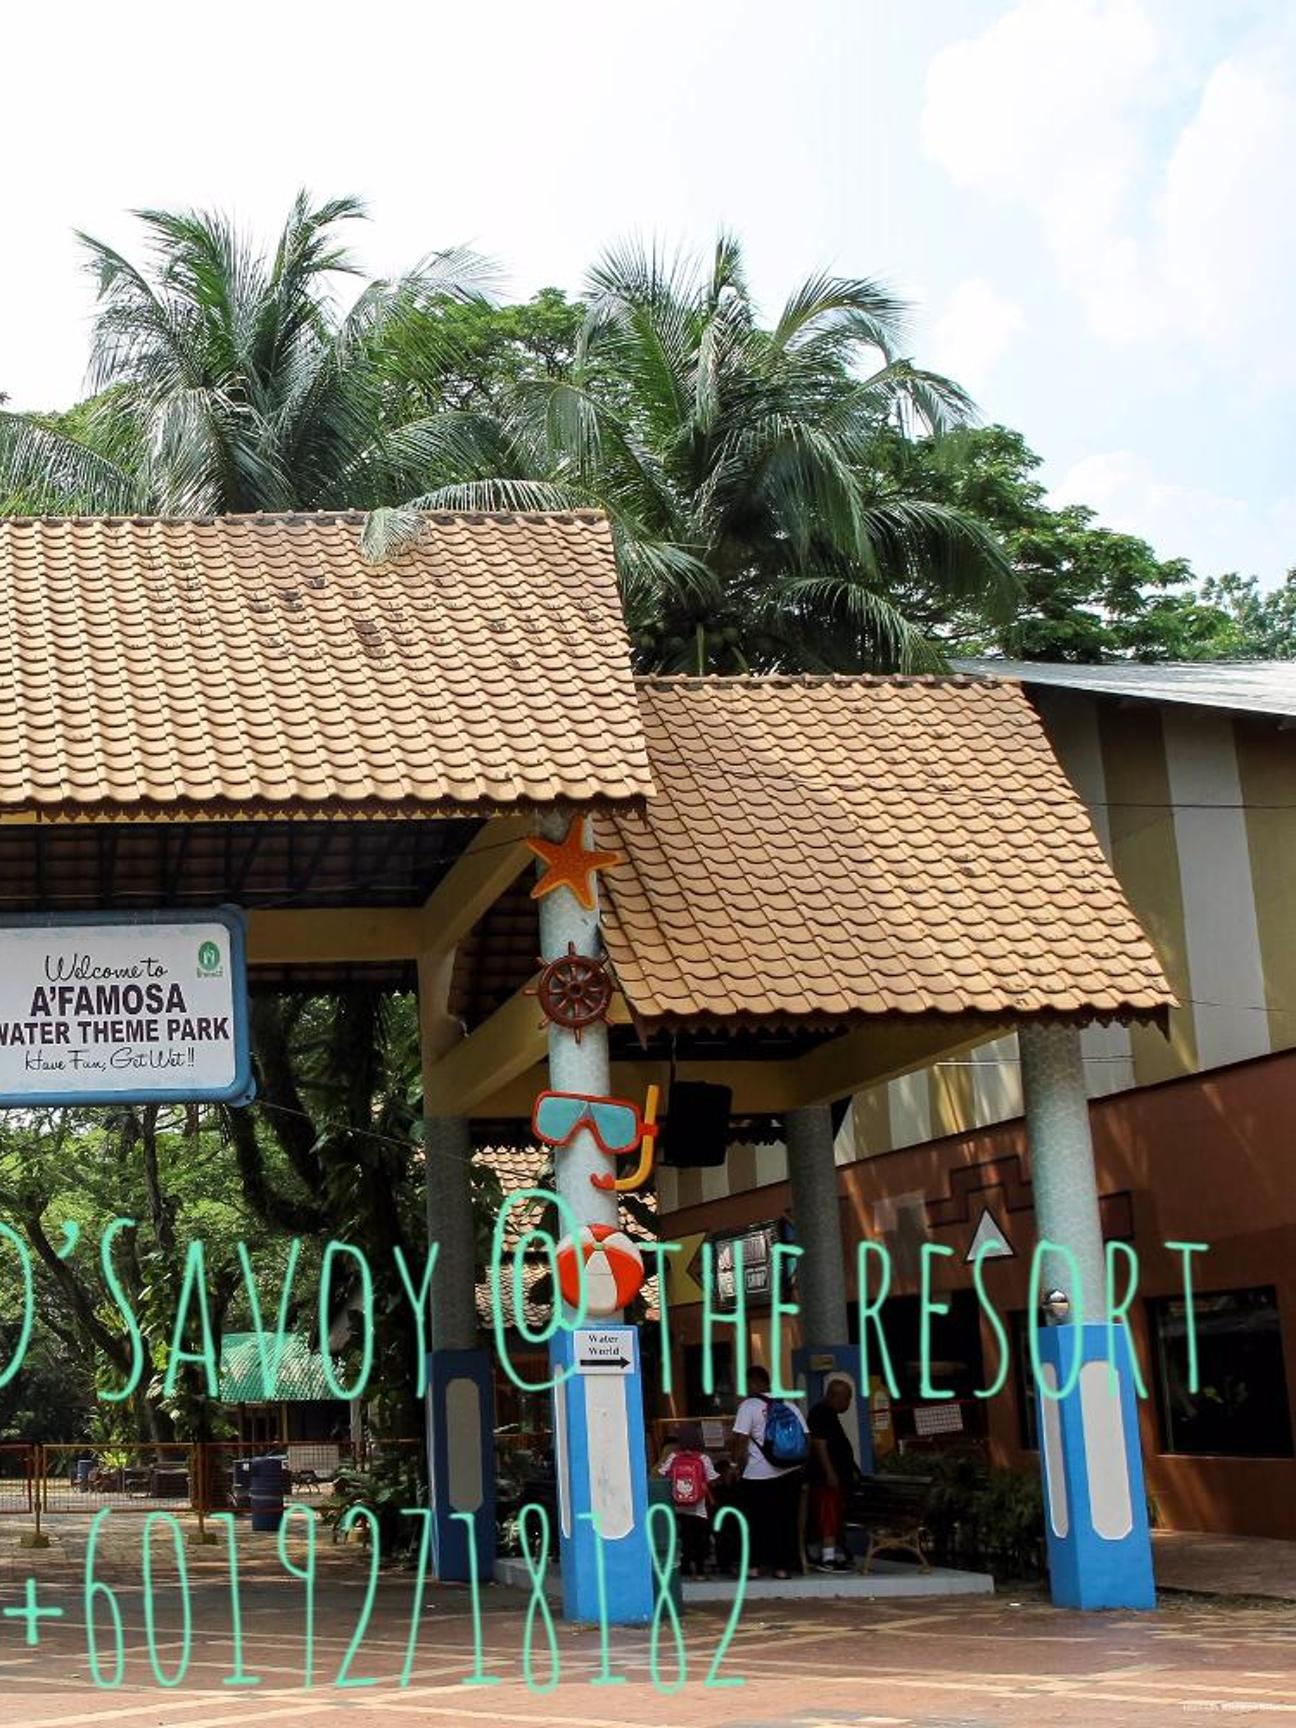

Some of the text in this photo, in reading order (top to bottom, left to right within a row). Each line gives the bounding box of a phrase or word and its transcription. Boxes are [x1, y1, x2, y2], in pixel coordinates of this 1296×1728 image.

[44, 953, 144, 982] Welcome
[140, 956, 168, 979] to
[30, 983, 187, 1016] A'FAMOSA
[77, 1020, 160, 1044] THEME
[167, 1016, 230, 1041] PARK
[25, 1050, 66, 1071] Have
[110, 1047, 148, 1070] Get
[588, 1335, 619, 1343] Water
[588, 1346, 620, 1355] World
